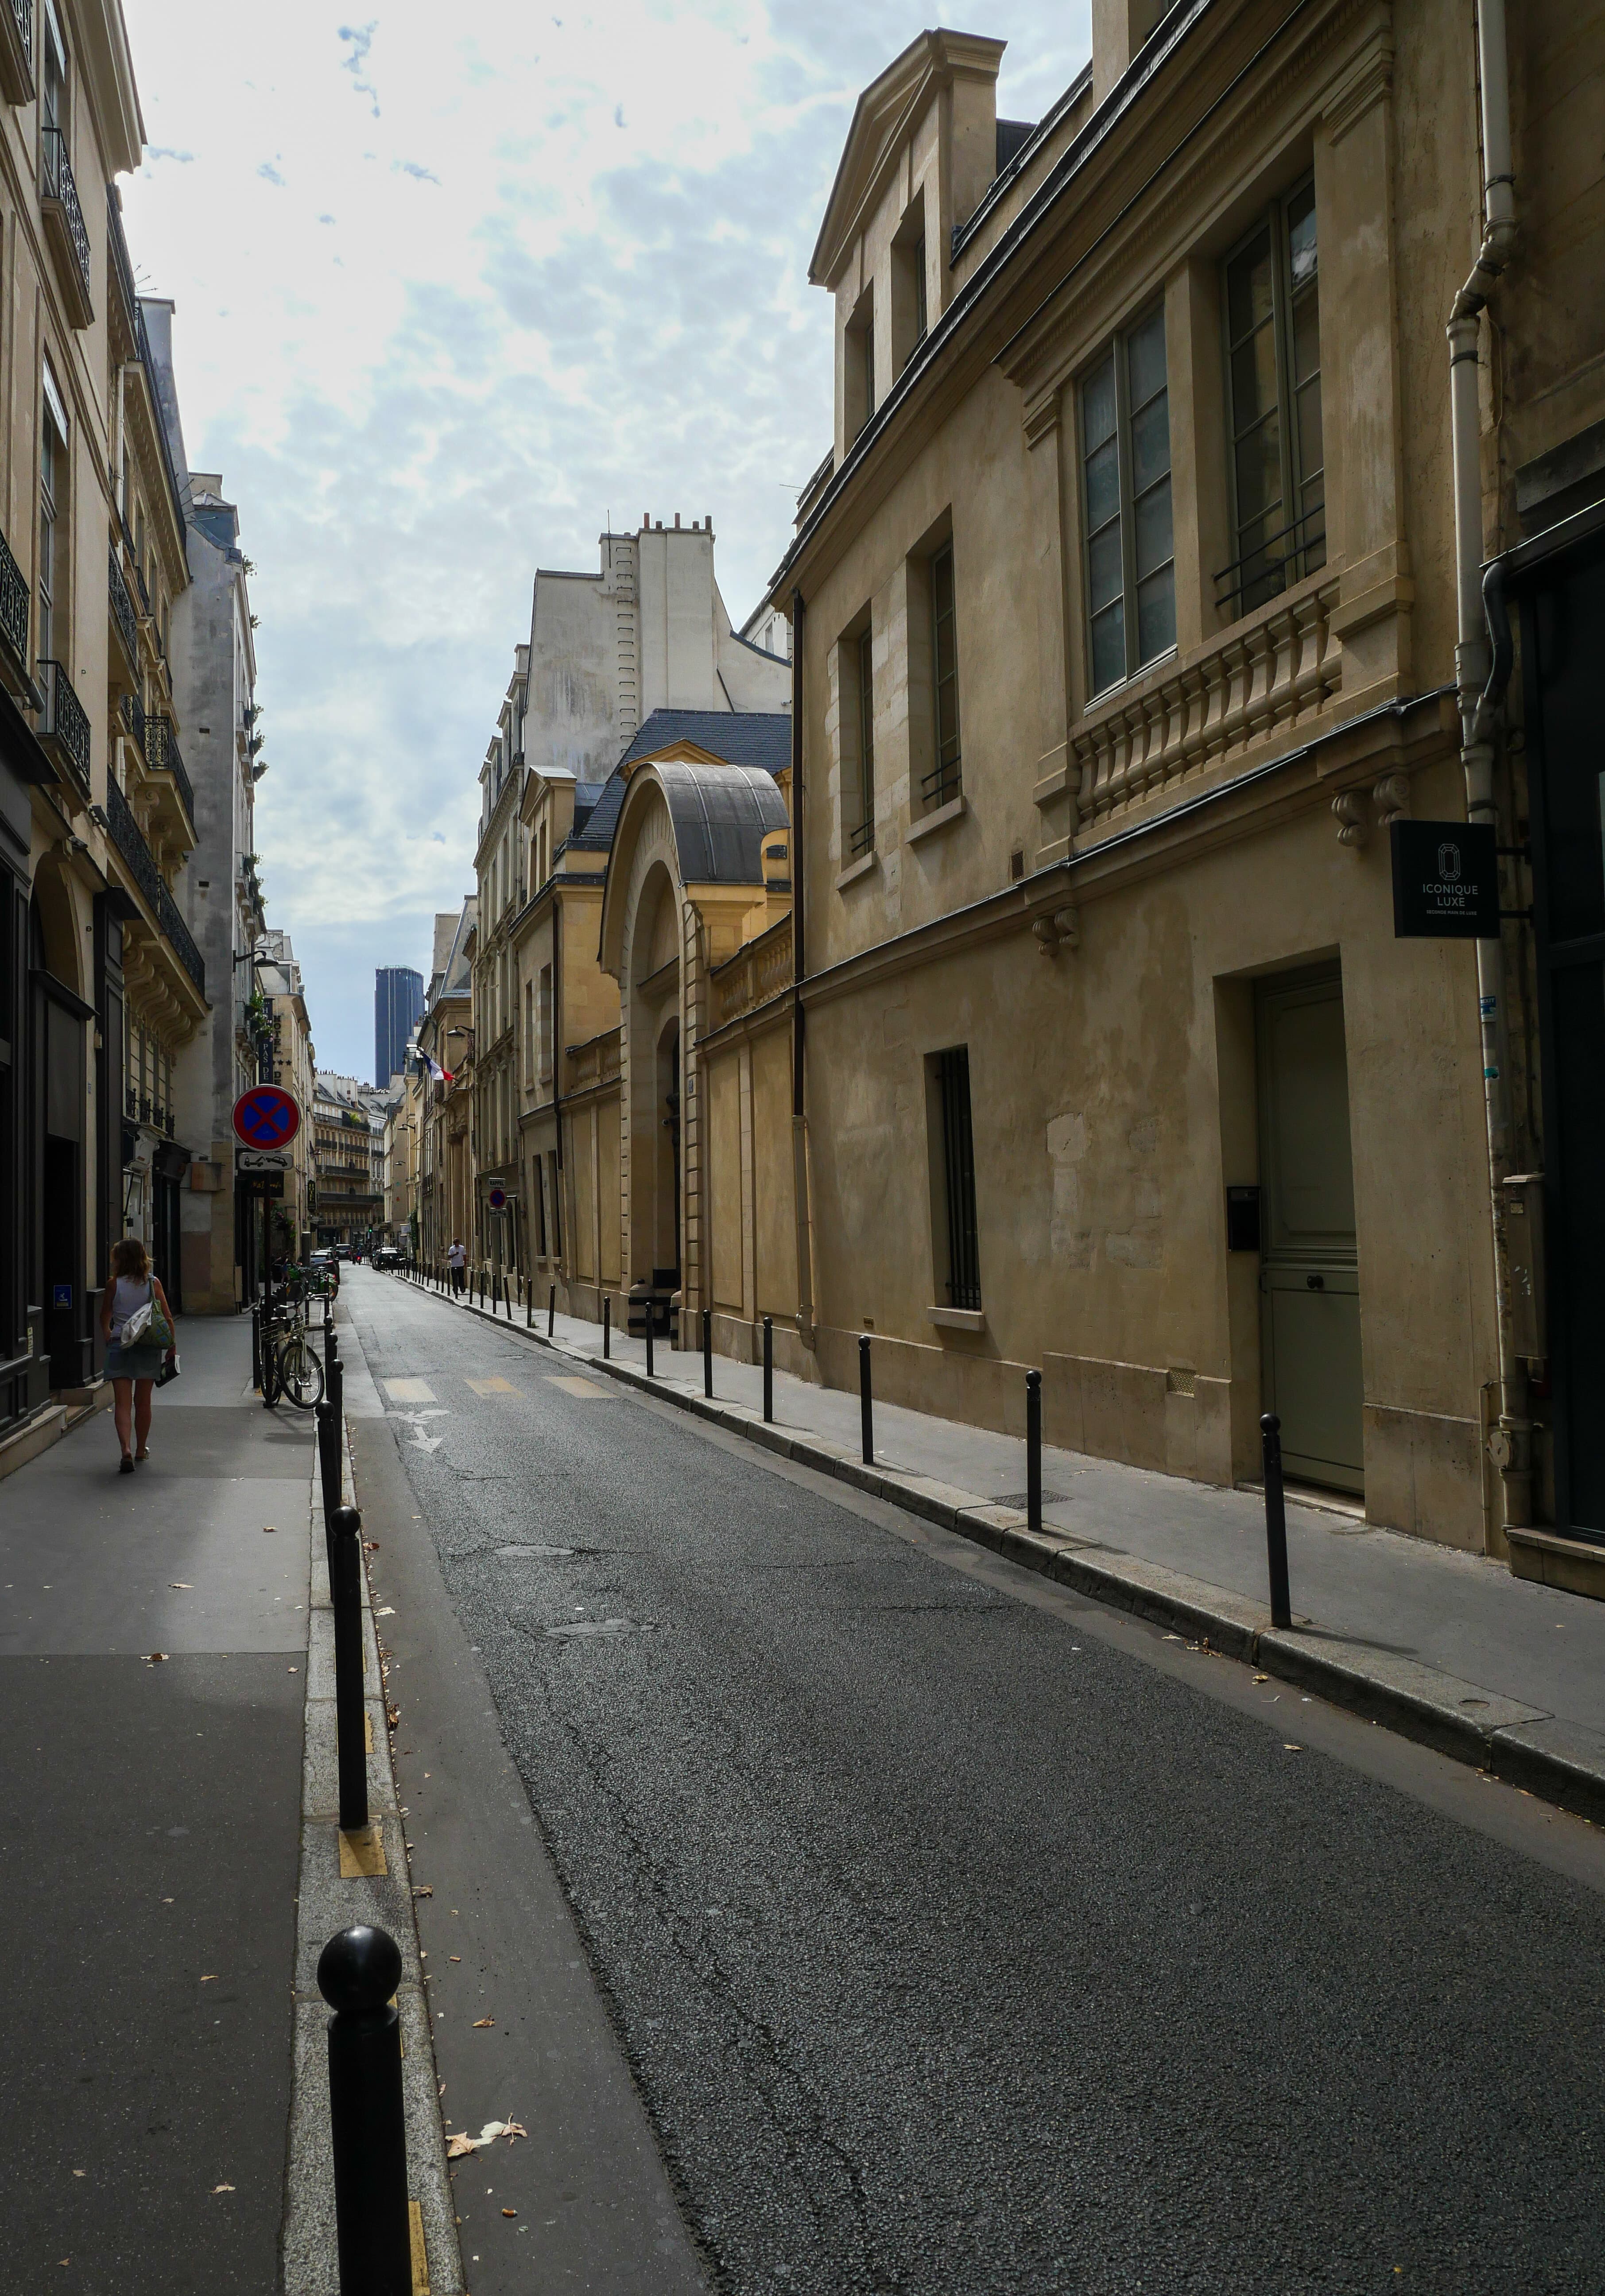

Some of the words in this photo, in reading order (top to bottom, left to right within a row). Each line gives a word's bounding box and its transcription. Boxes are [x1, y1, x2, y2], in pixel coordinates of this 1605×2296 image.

[1423, 884, 1478, 896] ICONIQUE
[1437, 896, 1465, 907] LUXE
[263, 1067, 269, 1080] DE
